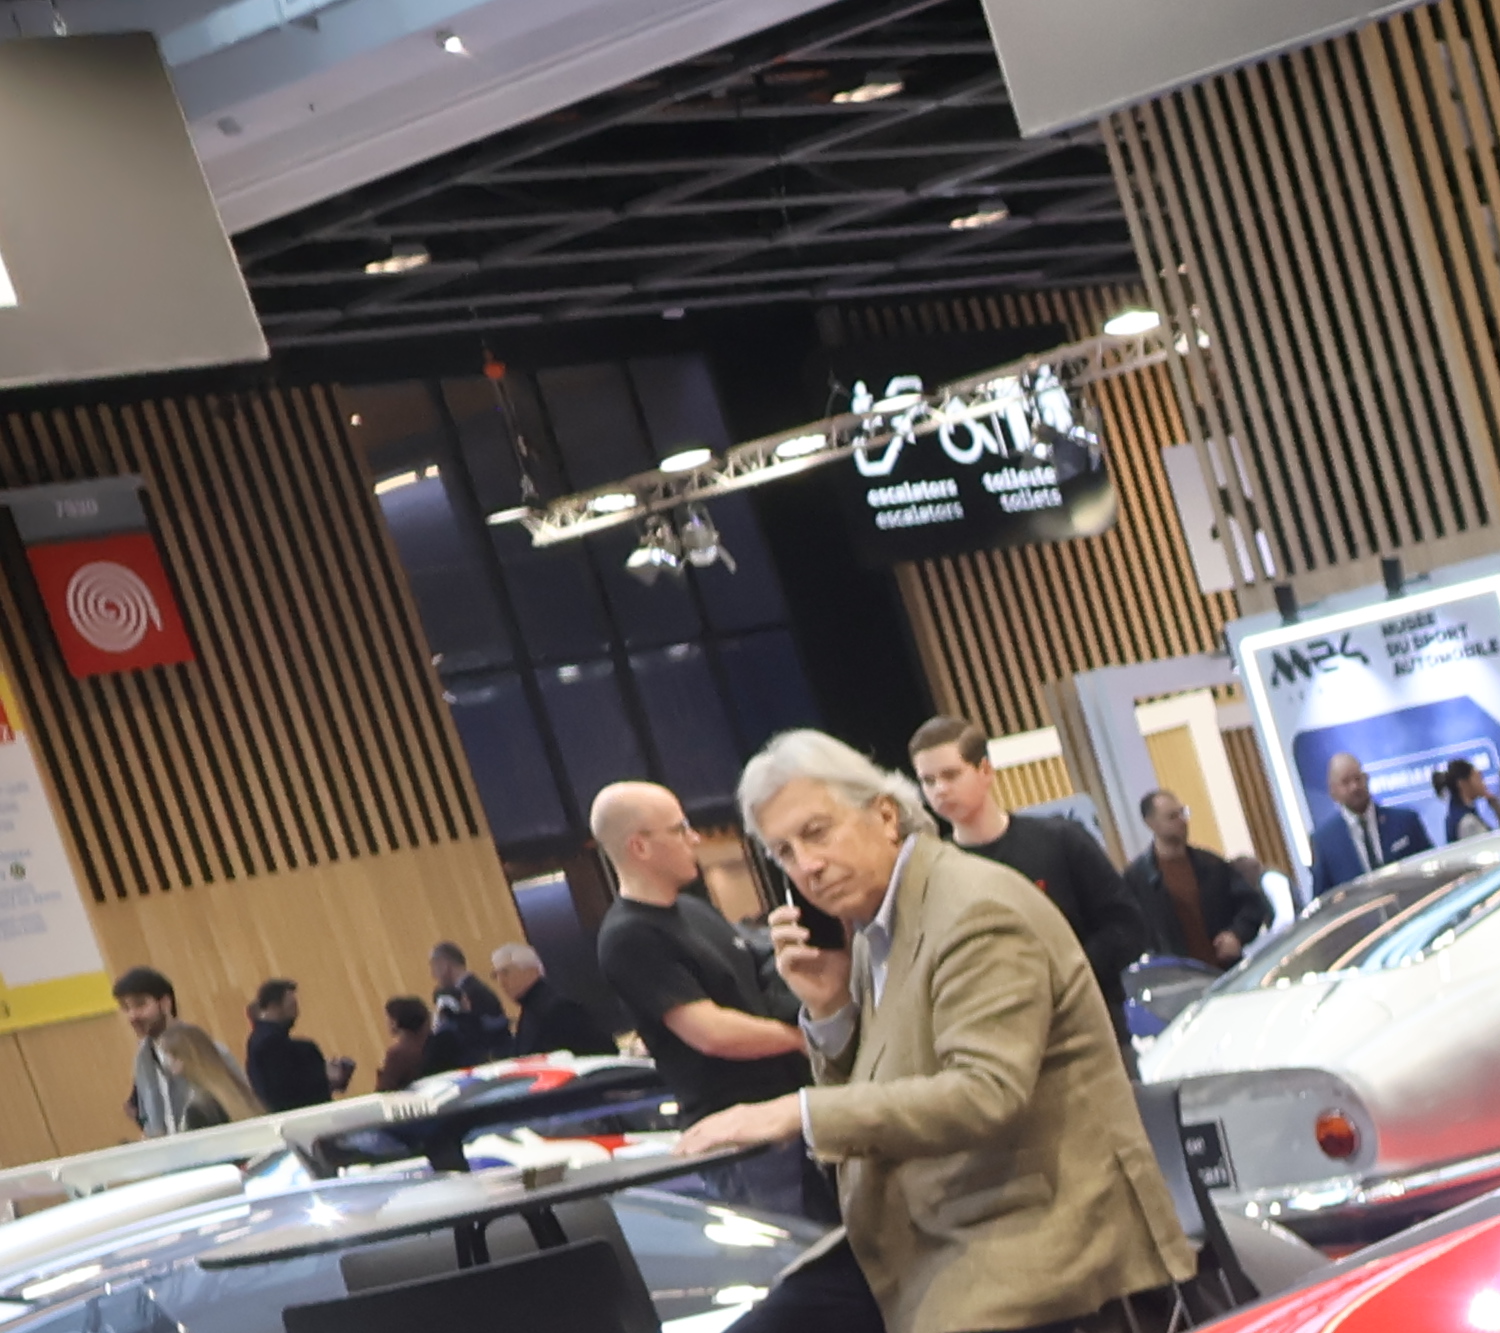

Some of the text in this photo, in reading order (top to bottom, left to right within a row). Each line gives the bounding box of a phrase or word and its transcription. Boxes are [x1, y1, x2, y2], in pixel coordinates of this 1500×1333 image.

[981, 465, 1057, 493] toilette
[1000, 487, 1063, 514] toilets
[1387, 622, 1470, 657] DU SPORT
[1395, 638, 1500, 678] AUTOMOBILE
